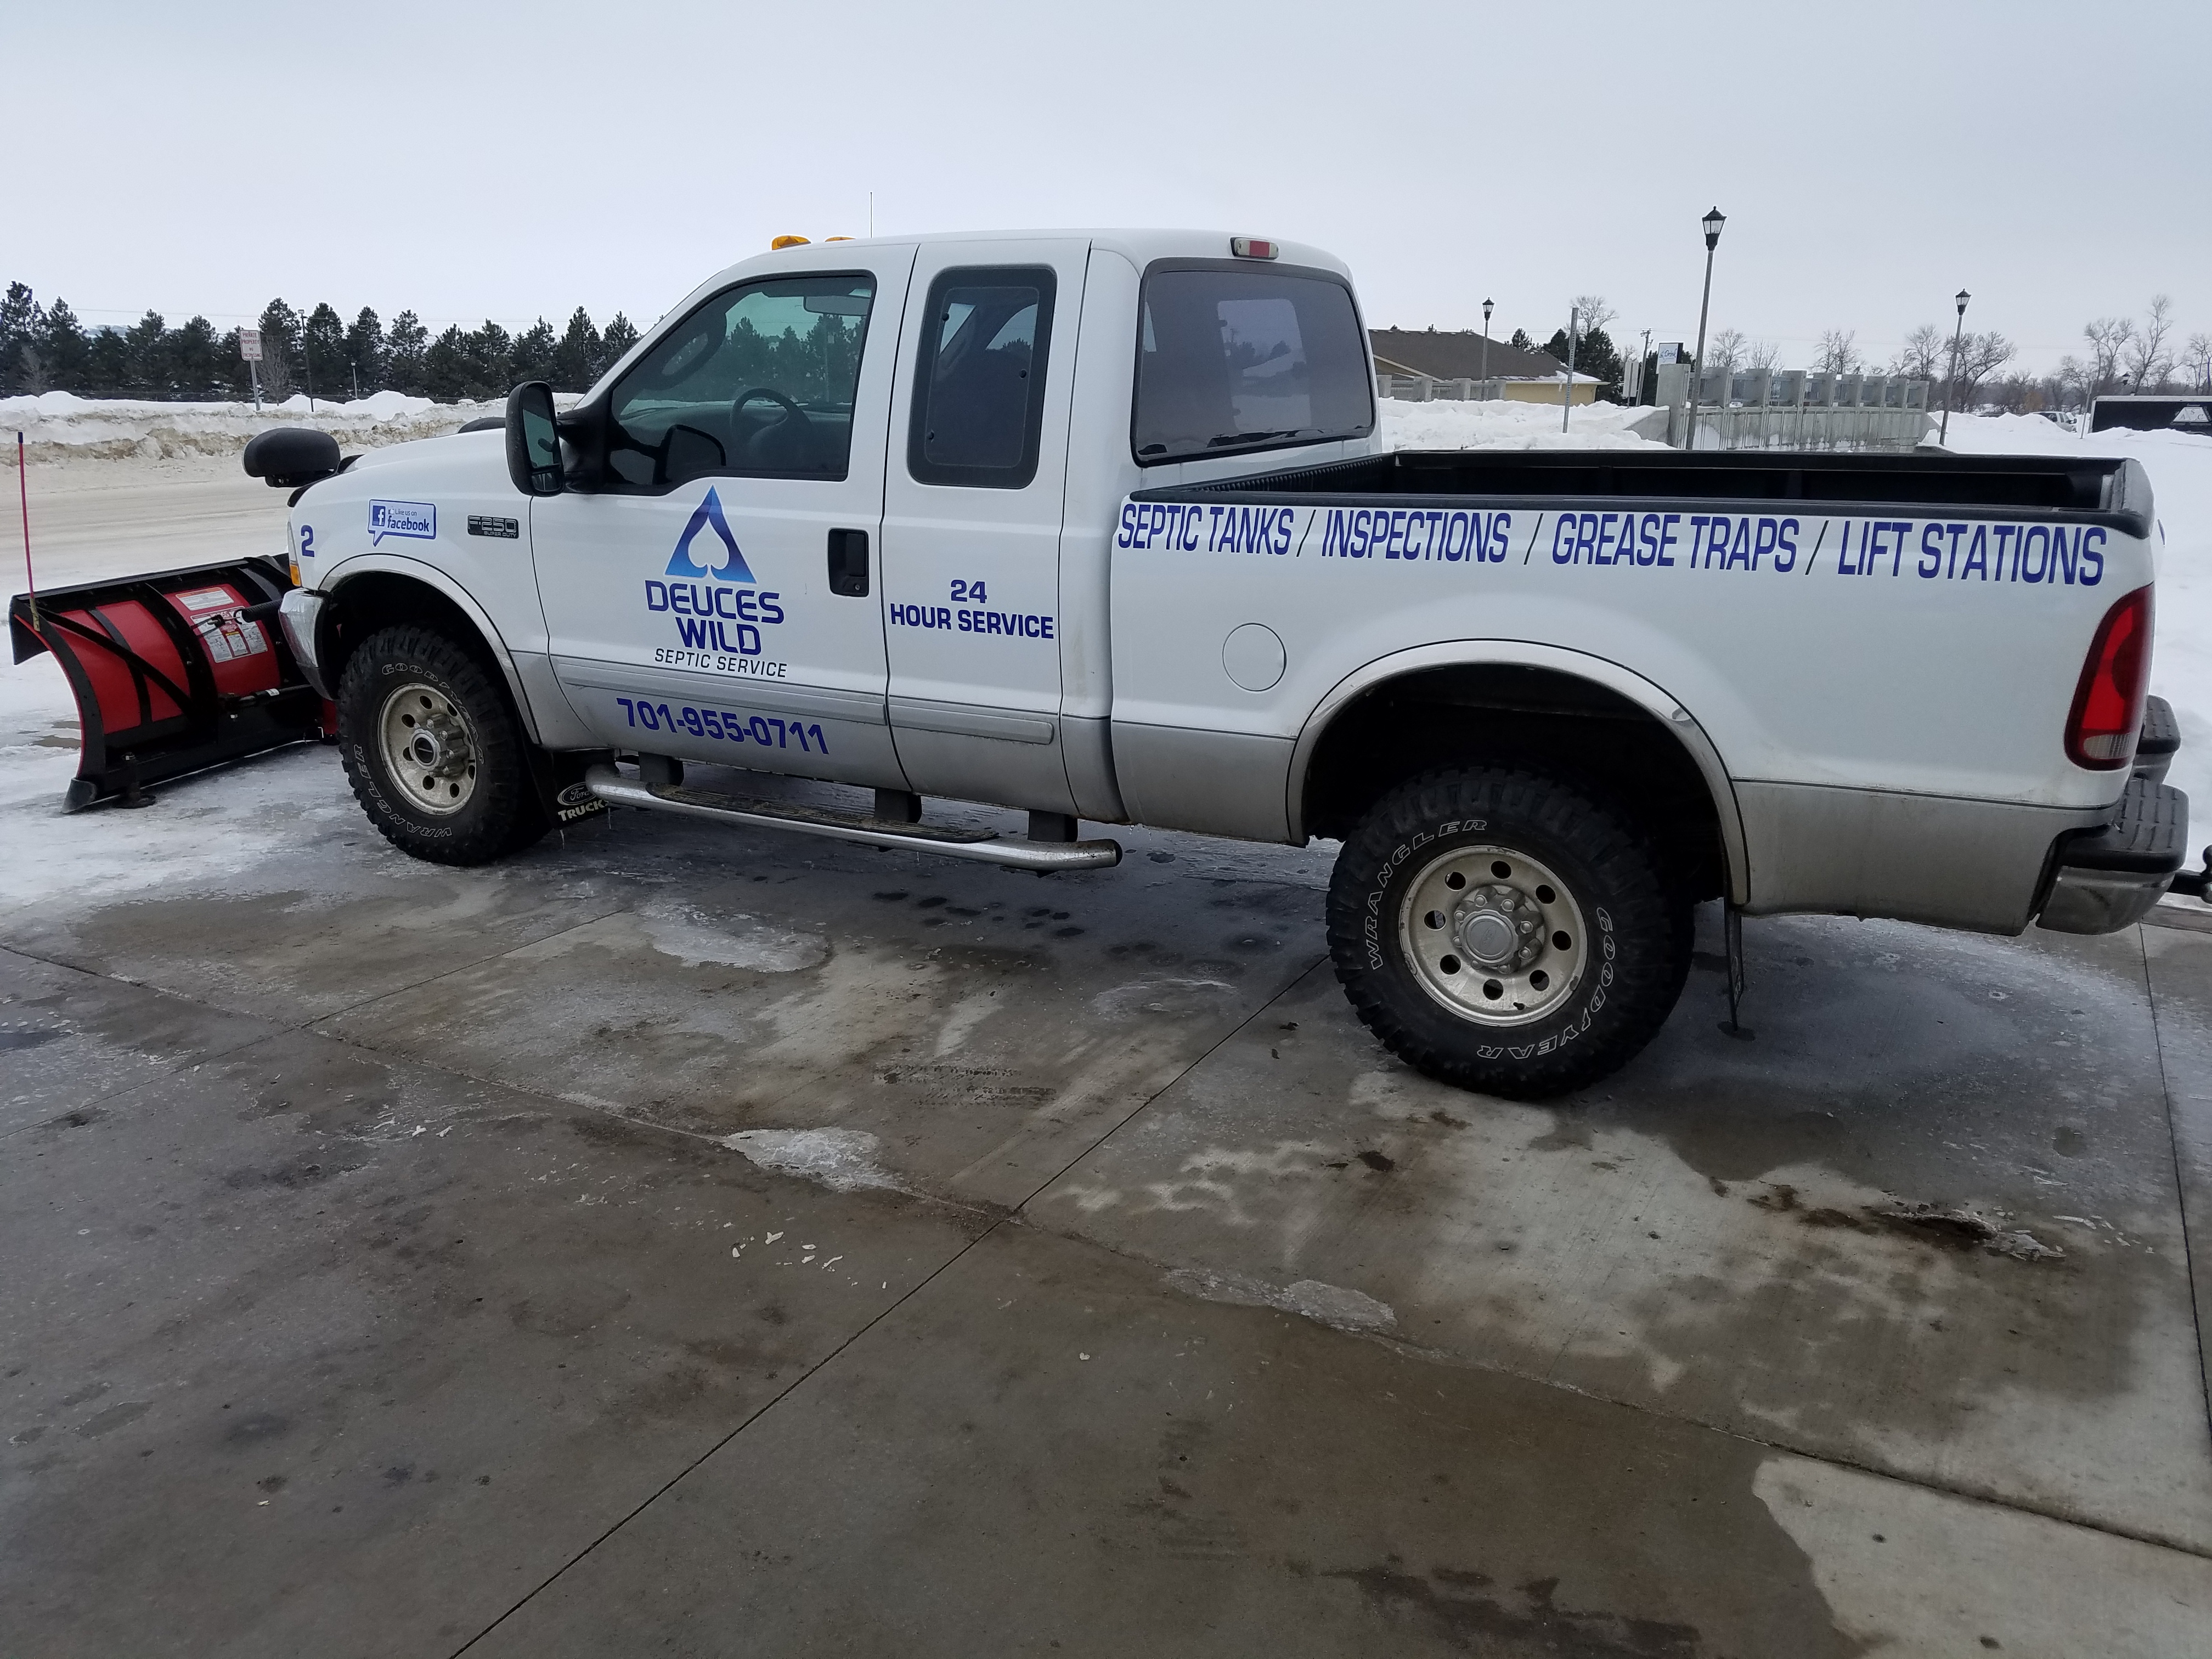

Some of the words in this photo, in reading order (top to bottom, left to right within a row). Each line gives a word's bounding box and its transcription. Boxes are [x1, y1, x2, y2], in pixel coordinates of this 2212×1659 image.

[301, 524, 315, 557] 2
[387, 515, 430, 532] facebook
[1119, 504, 1202, 551] SEPTIC
[1209, 507, 1294, 555] TANKS
[1322, 510, 1511, 562] INSPECTIONS
[1553, 514, 1681, 567] GREASE
[1691, 516, 1799, 572] TRAPS
[1838, 521, 1913, 577] LIFT
[1918, 523, 2107, 586] STATIONS
[645, 580, 784, 624] DEUCES
[951, 580, 987, 603] 24
[675, 617, 761, 655] WILD
[890, 603, 951, 630] HOUR
[958, 610, 1053, 639] SERVICE
[655, 648, 710, 668] SEPTIC
[717, 657, 787, 678] SERVICE
[617, 698, 829, 754] 701-955-0711
[354, 744, 452, 837] WRANGLER
[1365, 820, 1487, 969] WRANGLER
[1477, 907, 1615, 1059] GOODYEAR
